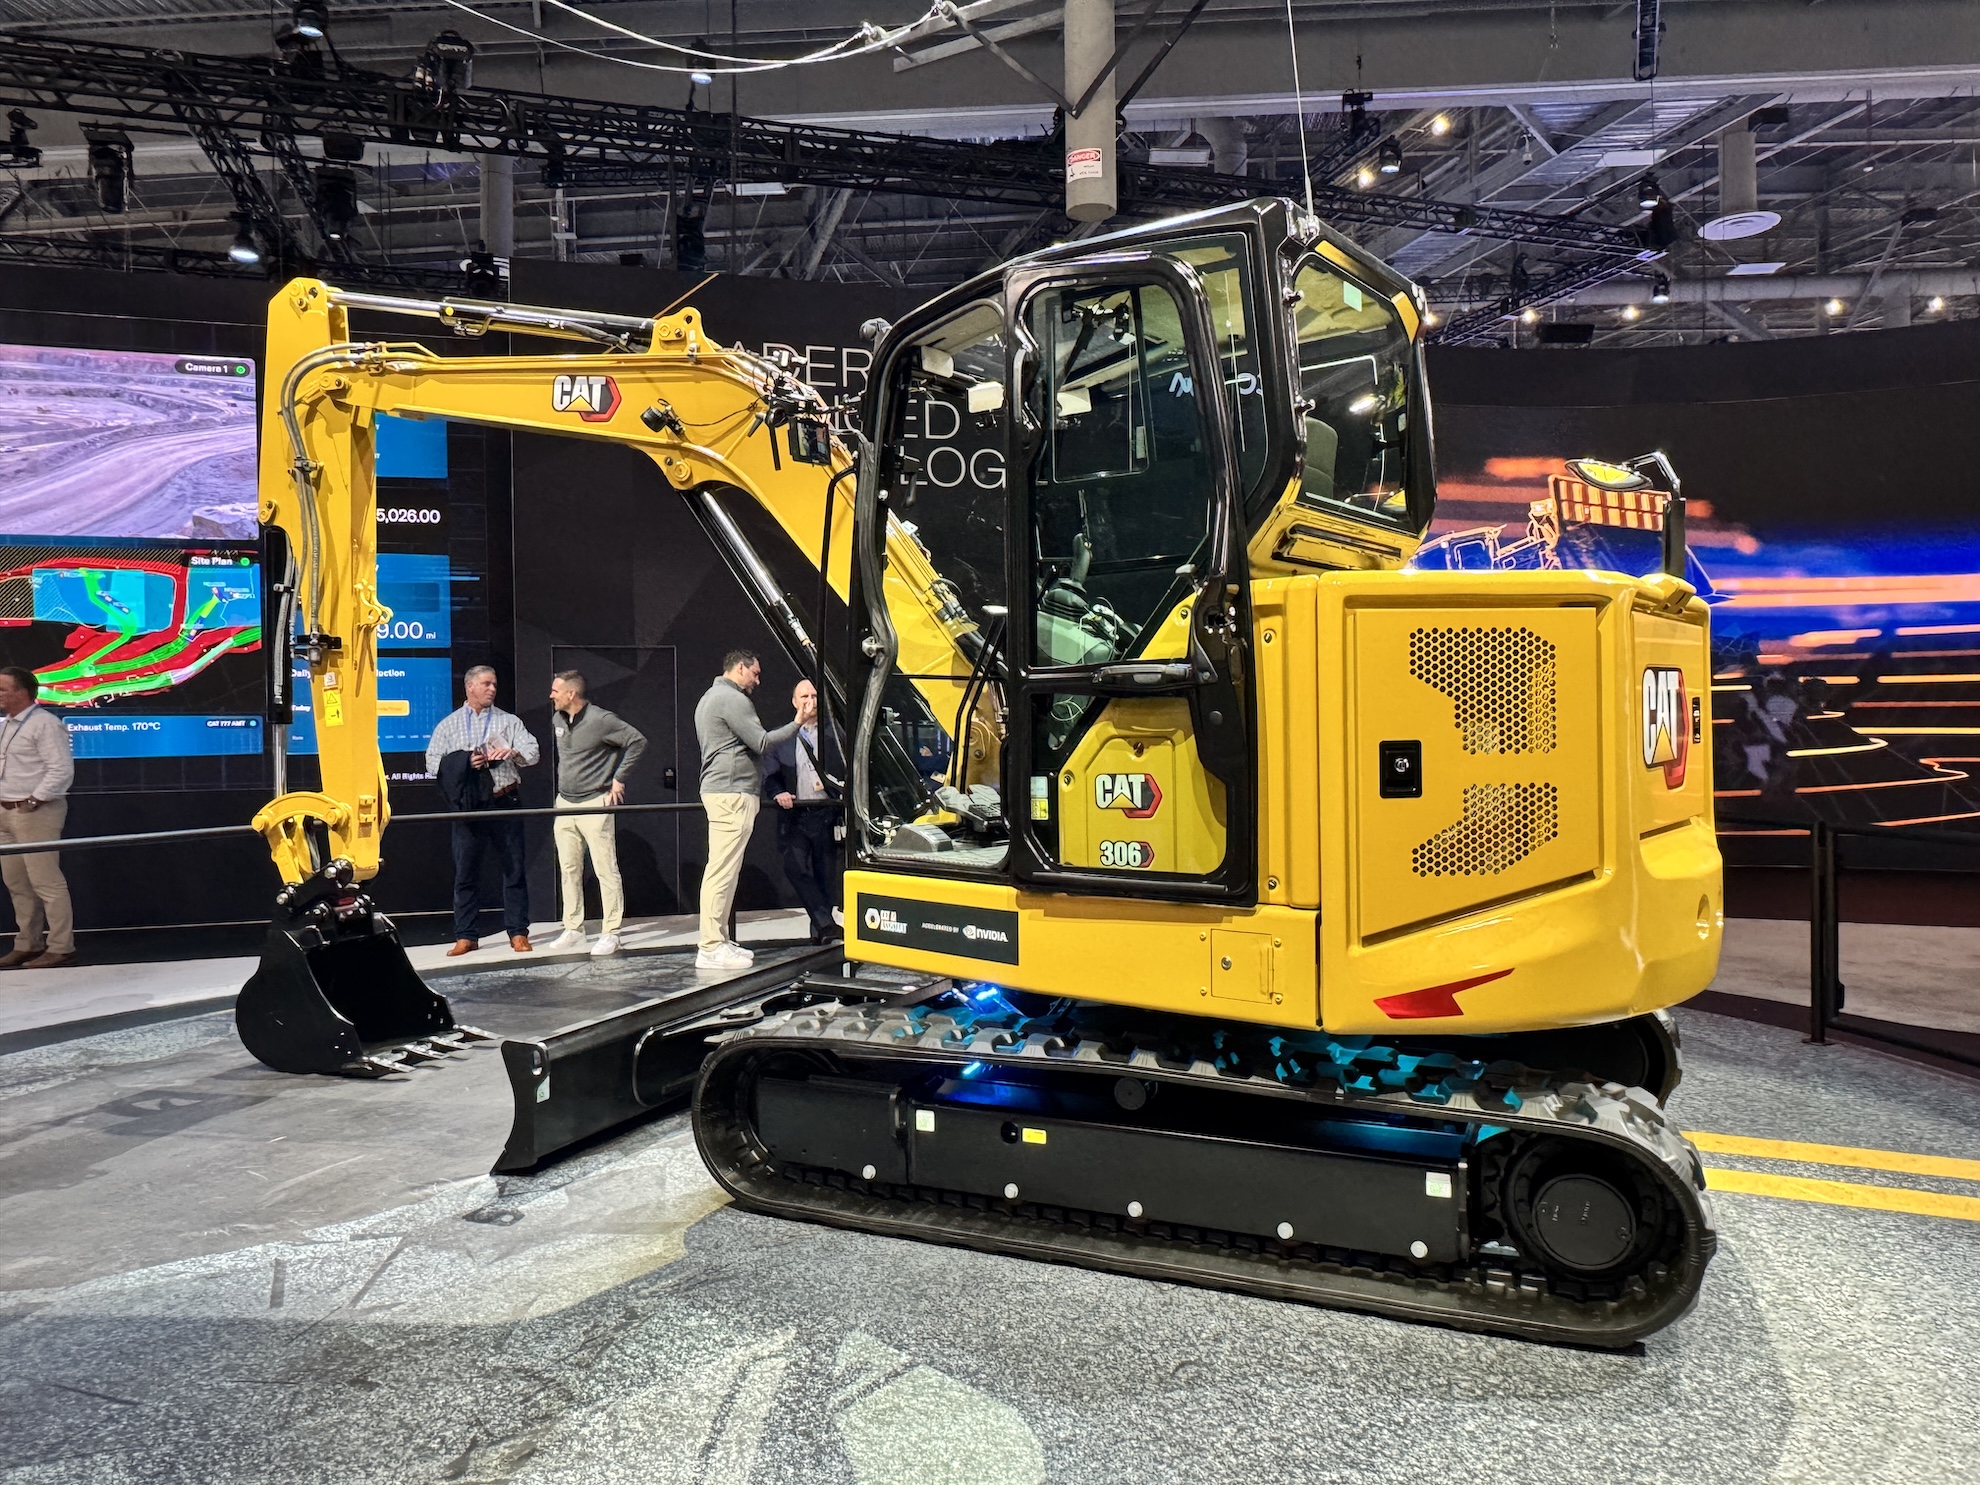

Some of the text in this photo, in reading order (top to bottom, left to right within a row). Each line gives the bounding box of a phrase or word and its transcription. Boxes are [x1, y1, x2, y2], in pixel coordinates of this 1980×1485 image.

[185, 362, 228, 373] Camera 1
[552, 375, 606, 412] CAT
[191, 557, 233, 566] Site Plan
[67, 723, 102, 731] Exhaust
[104, 723, 129, 731] Temp.
[1641, 668, 1681, 766] CAT
[1095, 774, 1146, 809] CAT
[1100, 840, 1142, 868] 306
